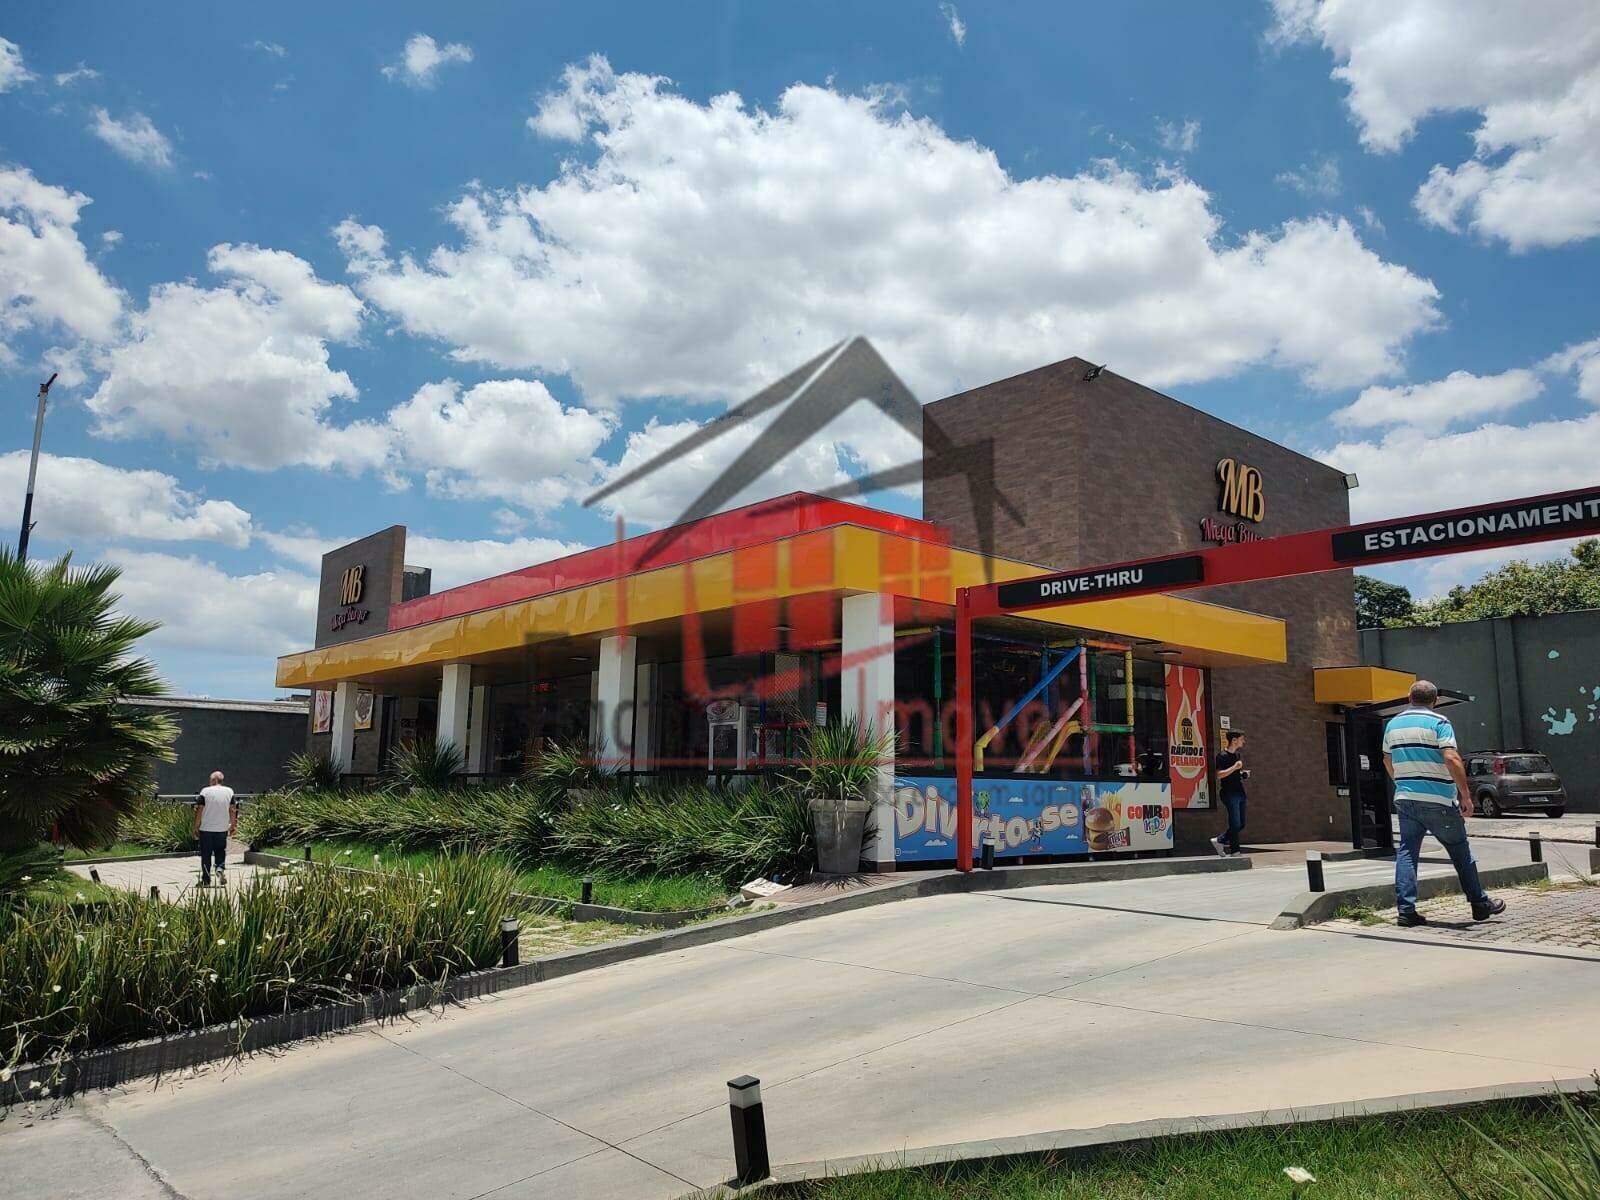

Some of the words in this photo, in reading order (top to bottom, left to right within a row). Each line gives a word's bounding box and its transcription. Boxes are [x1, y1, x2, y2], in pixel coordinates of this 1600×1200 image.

[1216, 458, 1264, 522] MB
[1200, 518, 1235, 545] Mega
[1364, 499, 1600, 551] ESTACIONAMENT
[340, 565, 362, 606] MB
[1040, 569, 1143, 597] DRIVE-THRU
[894, 784, 1079, 851] Divrta-se
[1127, 804, 1170, 820] COMBO
